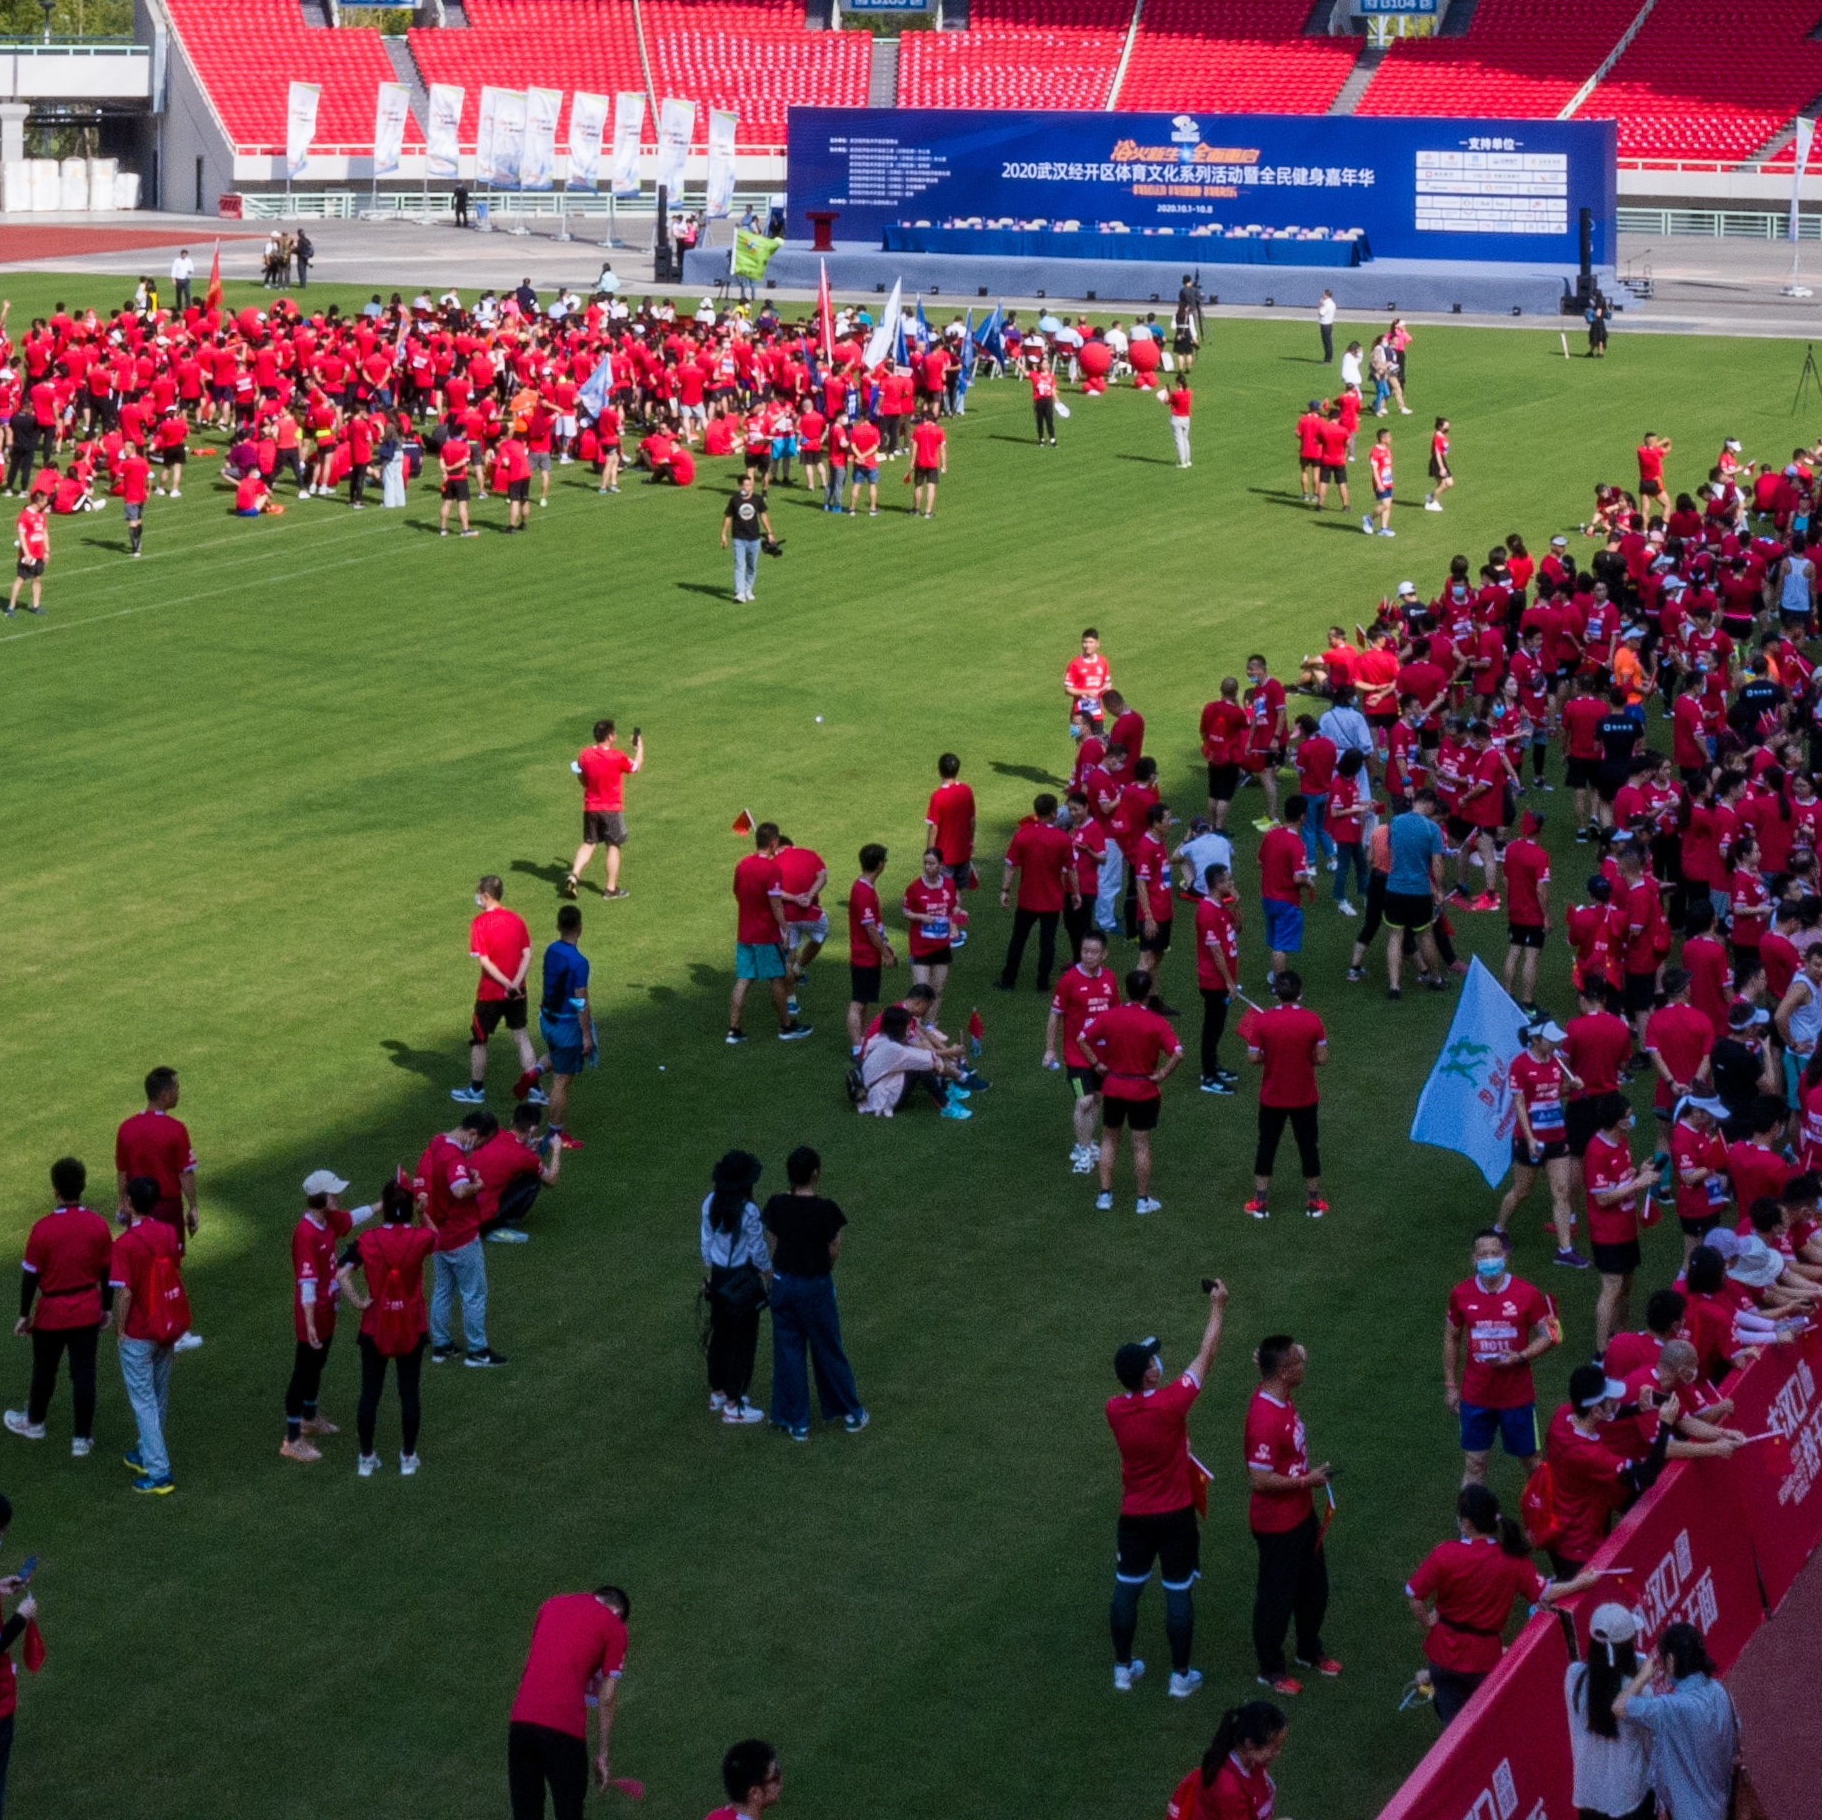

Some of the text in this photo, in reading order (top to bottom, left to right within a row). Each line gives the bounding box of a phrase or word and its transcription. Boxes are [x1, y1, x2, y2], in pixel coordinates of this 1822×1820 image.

[1468, 137, 1515, 151] 支持单位
[1001, 161, 1375, 188] 2020武汉经开区体育文化系列活动暨全民健身嘉年华
[1156, 203, 1213, 214] 2020.10.1-10.8
